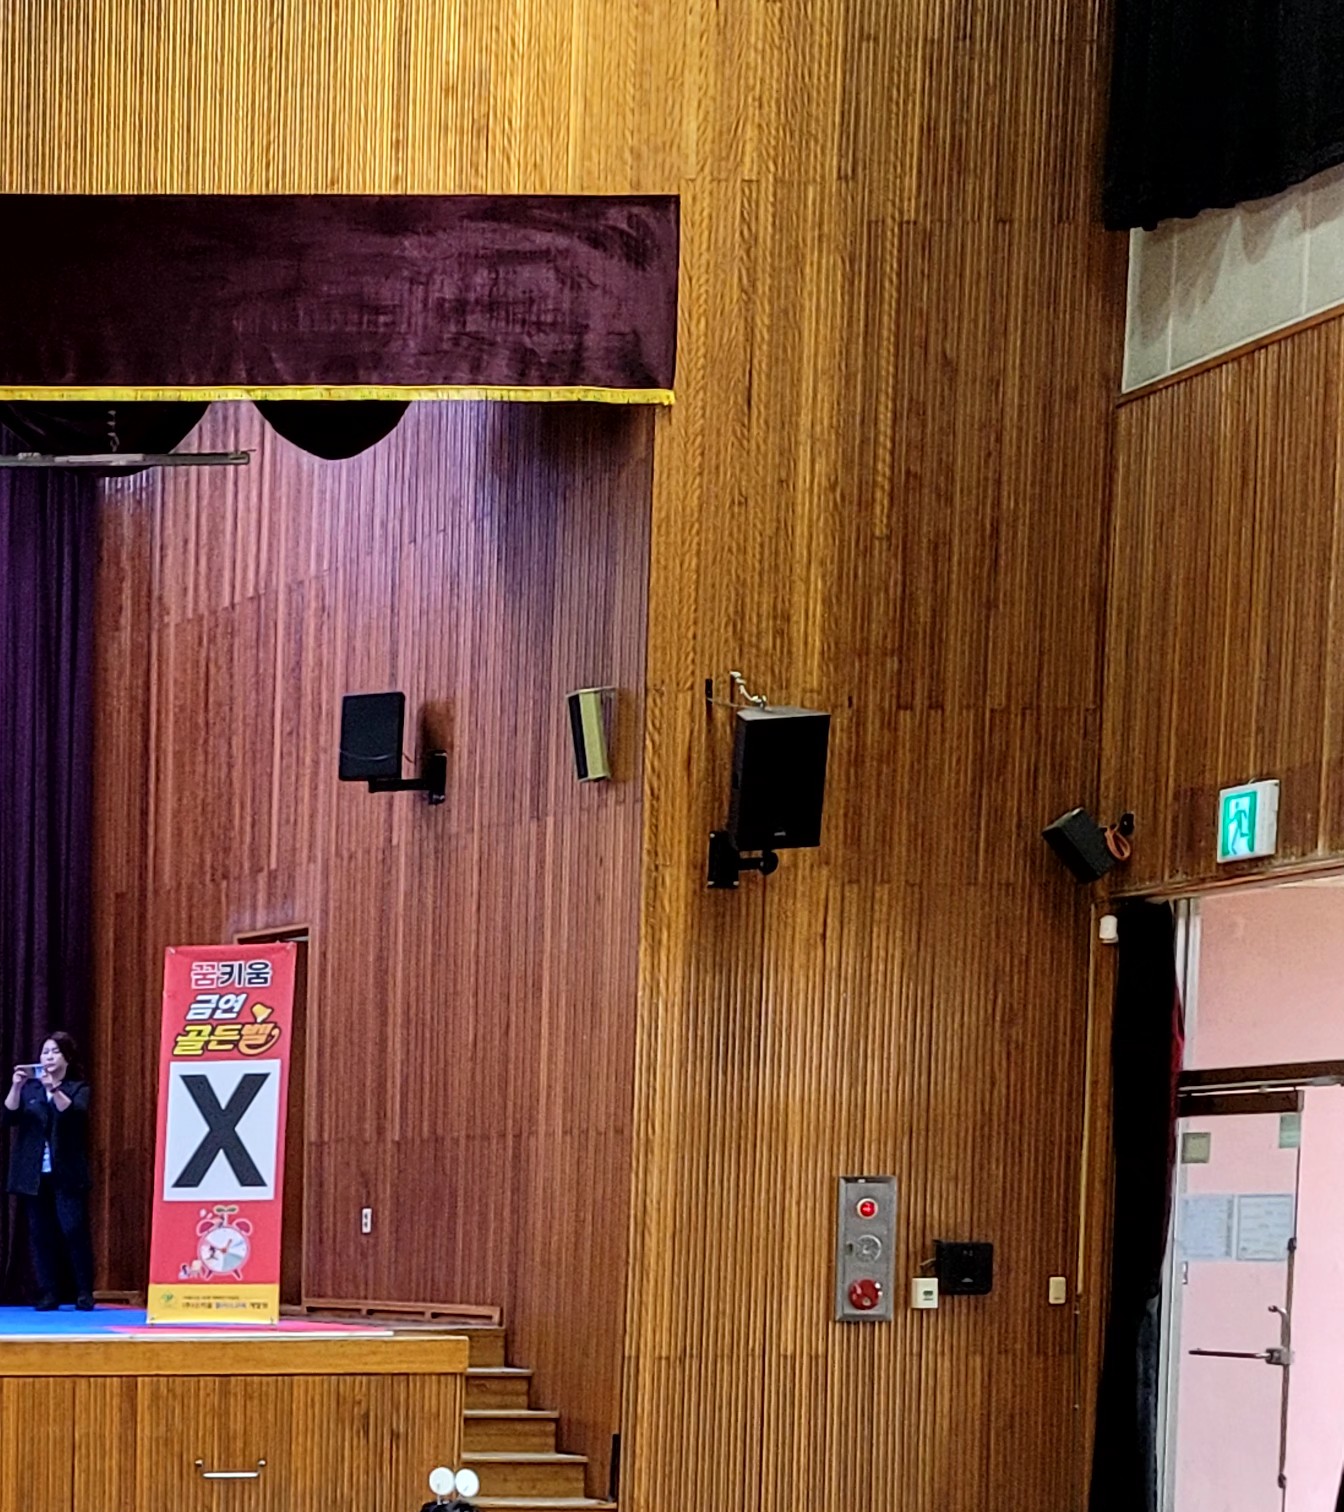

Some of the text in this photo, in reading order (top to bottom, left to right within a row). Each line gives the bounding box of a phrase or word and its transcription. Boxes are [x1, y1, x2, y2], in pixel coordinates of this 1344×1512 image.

[190, 959, 273, 990] 꿈키움
[185, 992, 248, 1022] 금연
[172, 1021, 282, 1057] 골든벨
[171, 1072, 271, 1189] X
